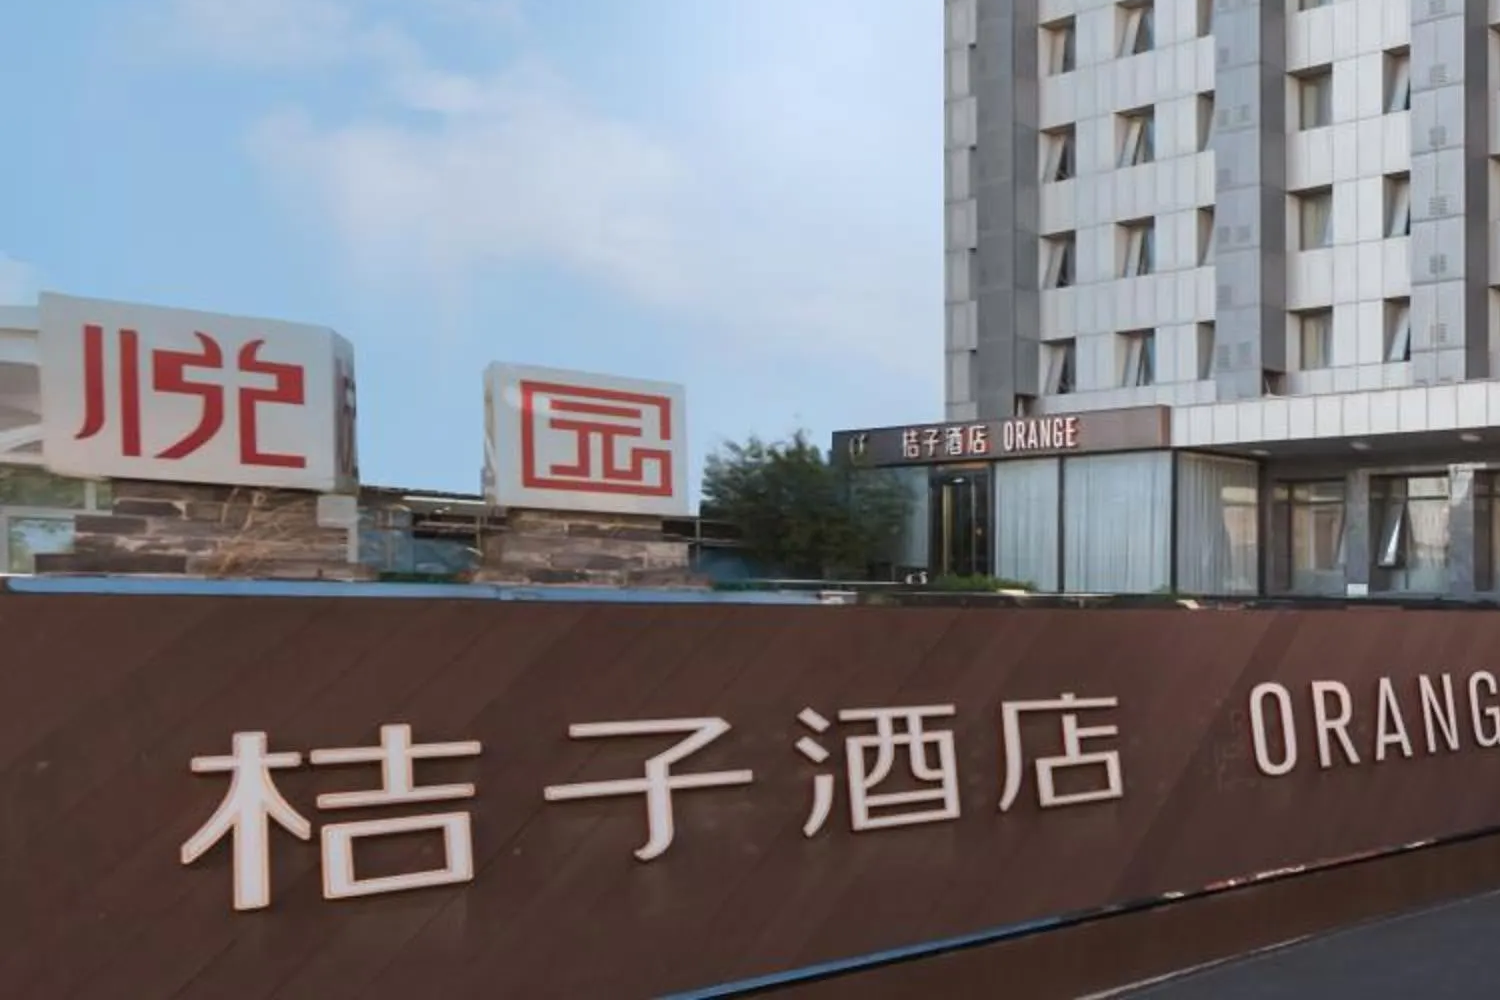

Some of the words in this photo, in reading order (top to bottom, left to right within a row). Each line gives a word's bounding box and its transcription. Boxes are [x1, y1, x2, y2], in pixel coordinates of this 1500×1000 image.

[902, 425, 989, 459] 桔子酒店
[1003, 416, 1080, 451] ORANGE
[181, 692, 1123, 910] 桔子酒店
